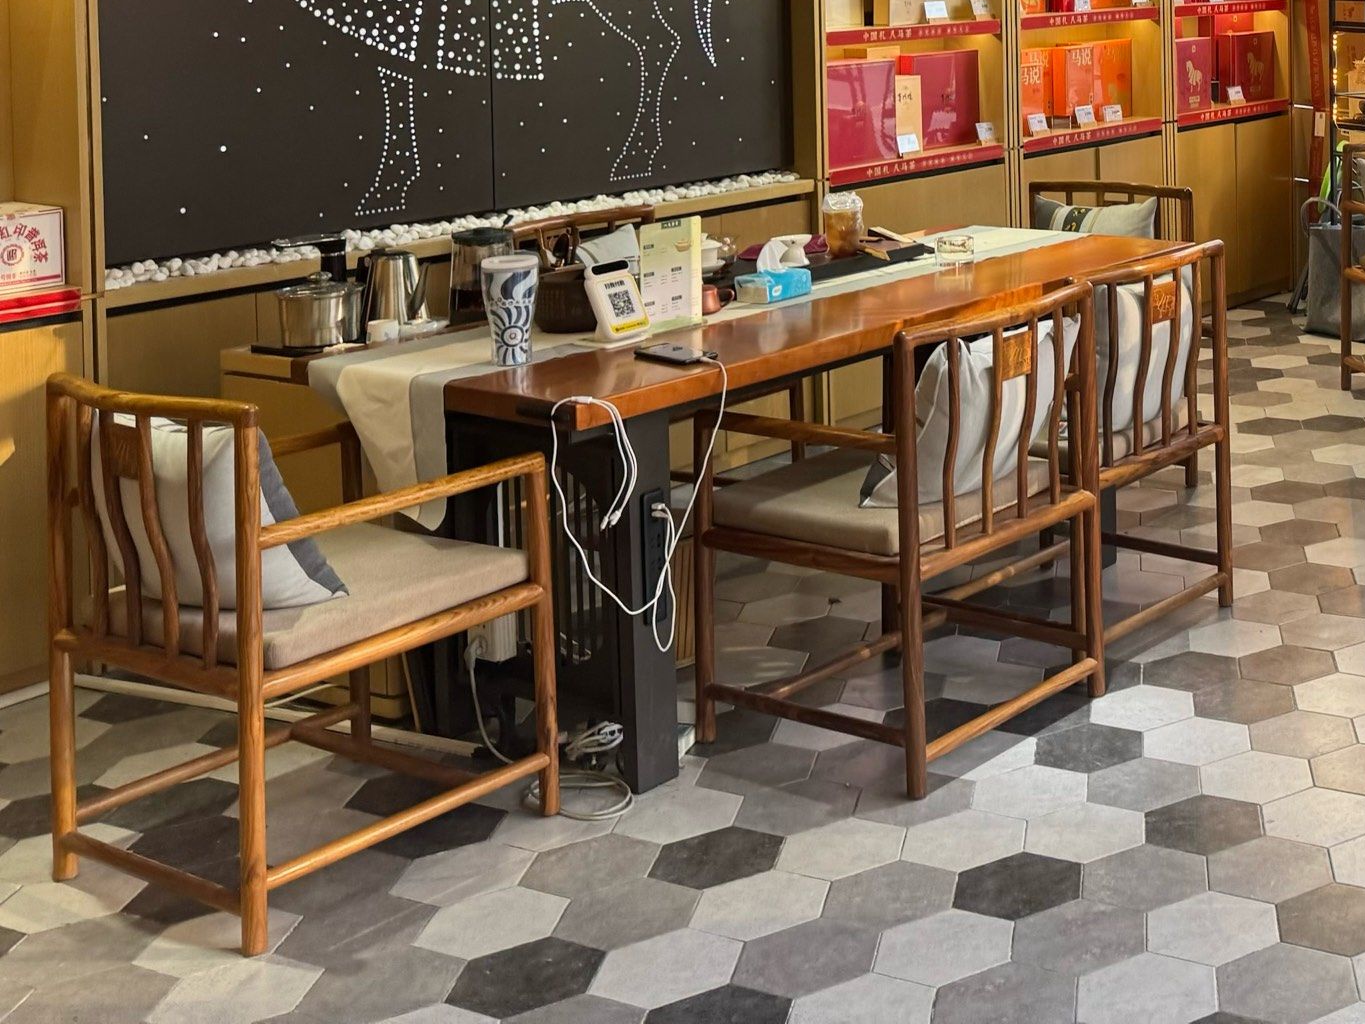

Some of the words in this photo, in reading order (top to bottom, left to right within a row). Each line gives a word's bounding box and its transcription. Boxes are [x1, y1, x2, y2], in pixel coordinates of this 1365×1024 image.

[863, 29, 887, 41] 中国礼
[889, 27, 912, 39] 八马茶
[867, 164, 890, 177] 中国礼
[893, 159, 916, 173] 八马茶
